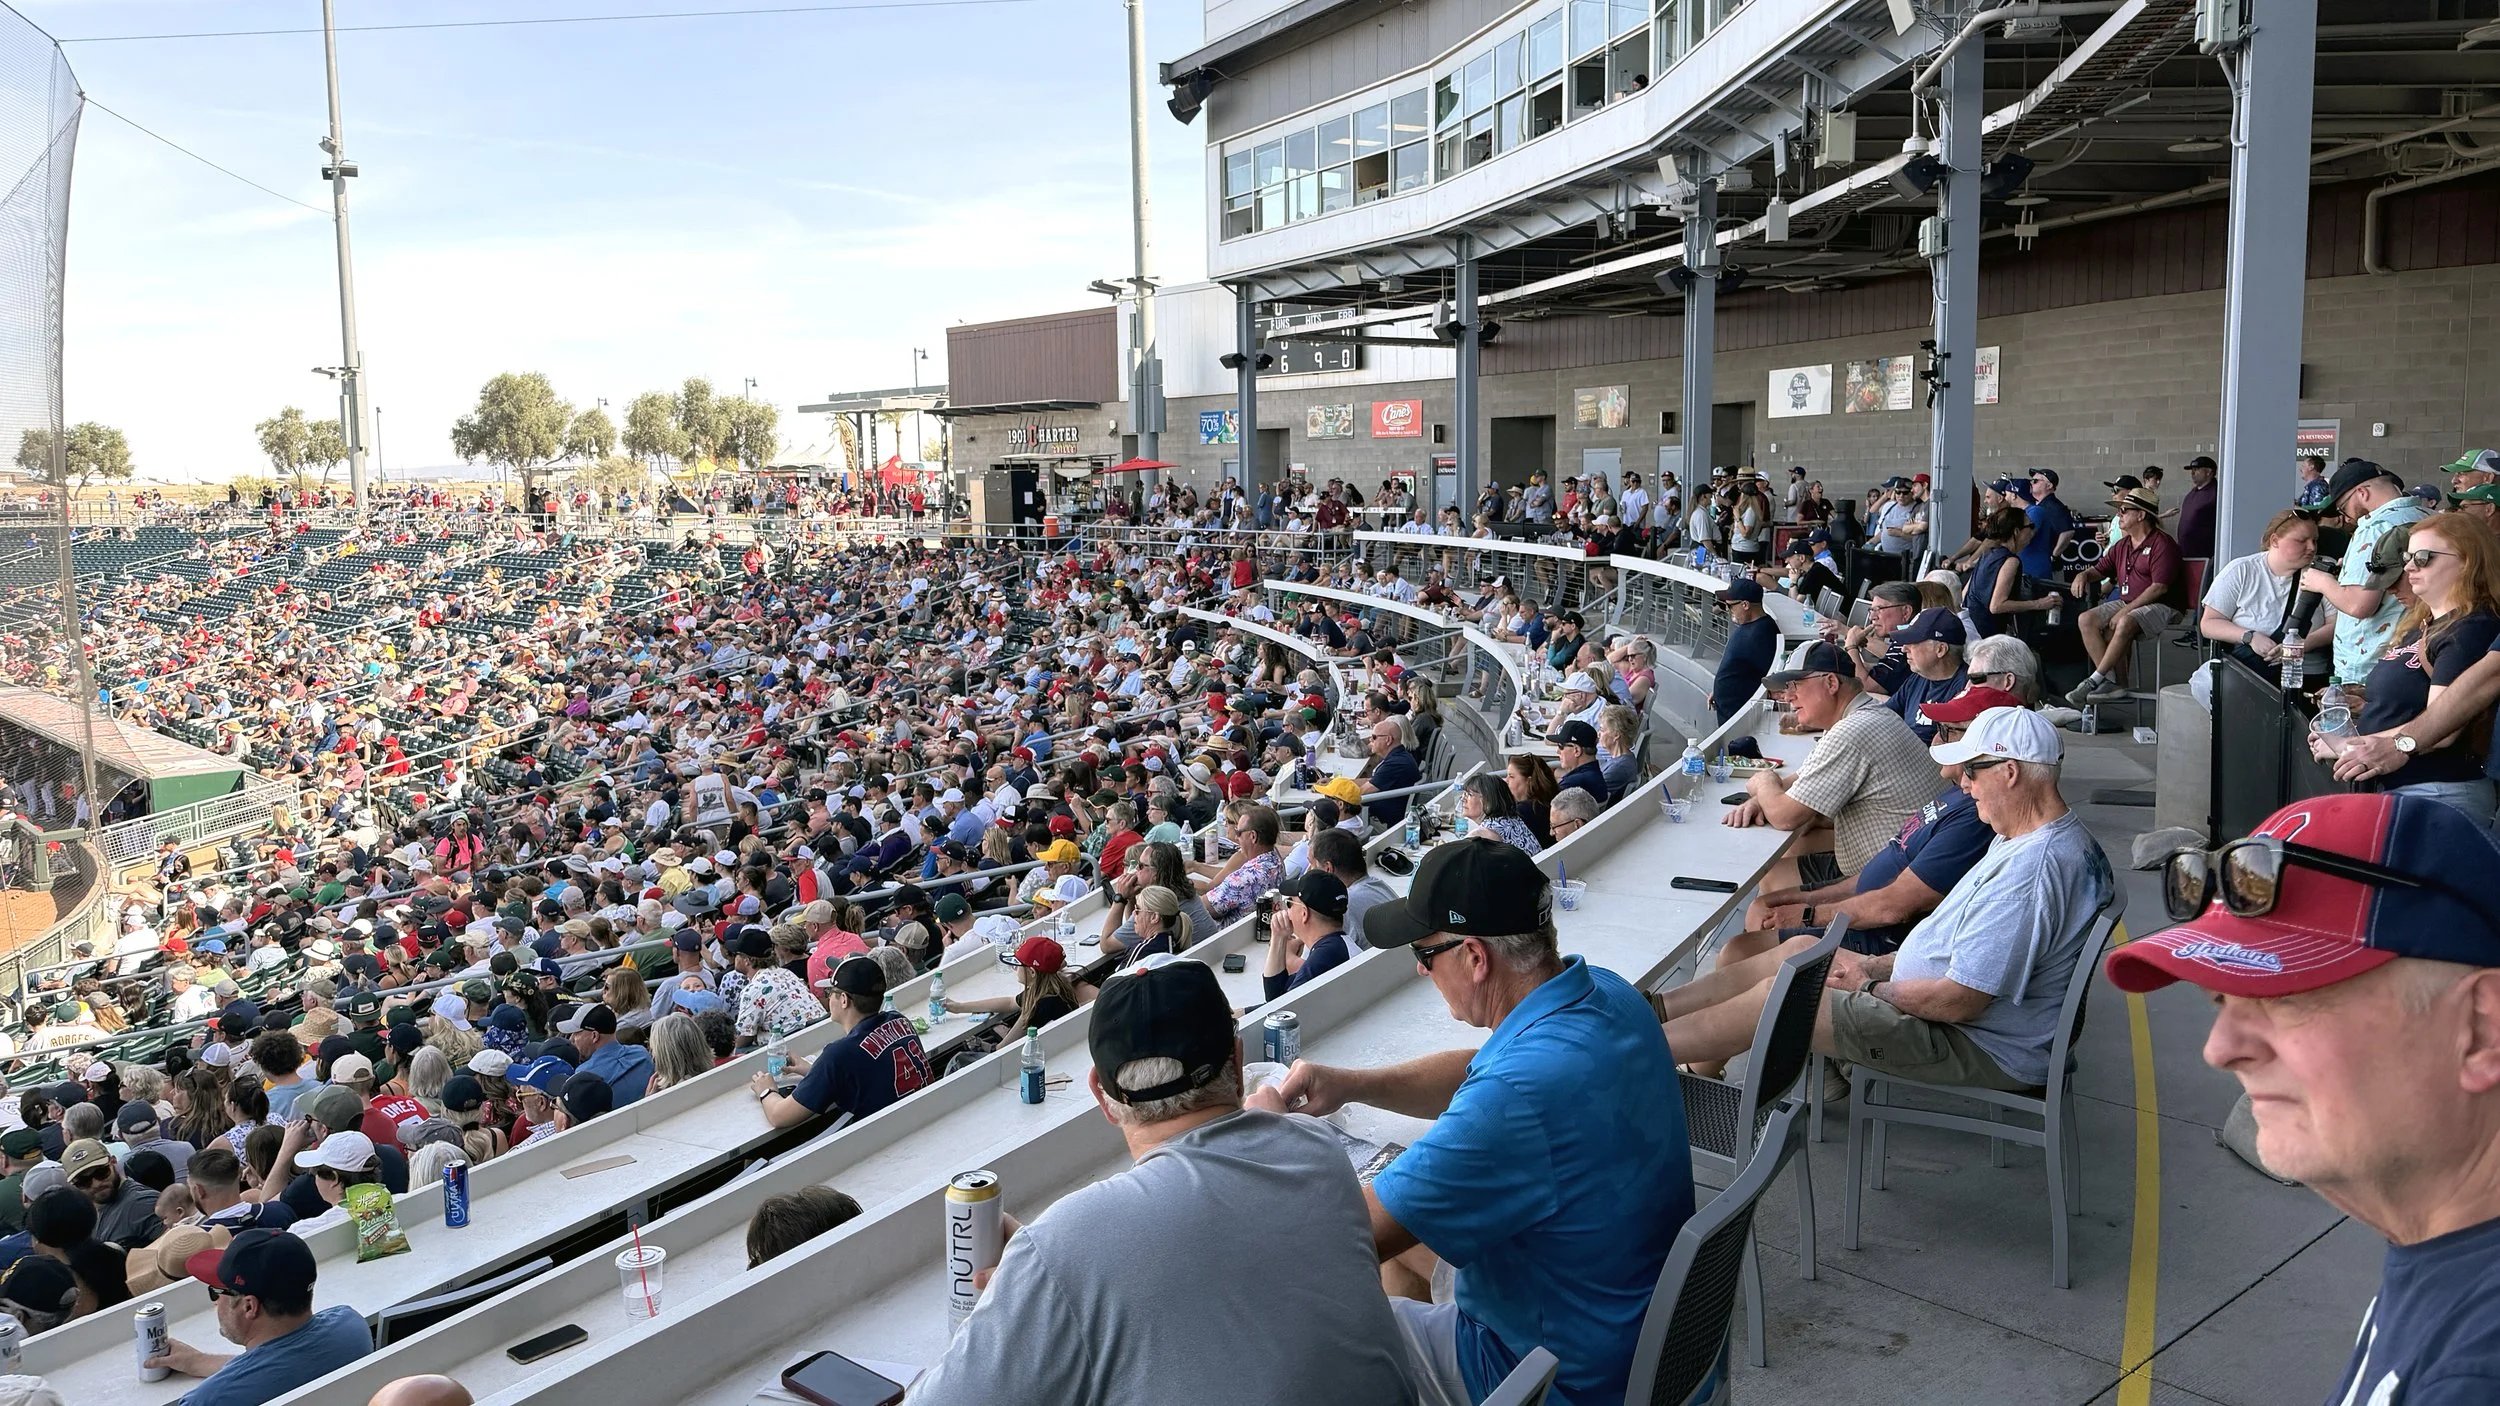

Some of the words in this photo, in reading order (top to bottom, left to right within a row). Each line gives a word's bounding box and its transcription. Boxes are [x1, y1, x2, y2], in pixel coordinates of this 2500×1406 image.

[1281, 355, 1289, 373] 6
[1314, 351, 1323, 369] 9
[1341, 349, 1350, 368] 0
[1008, 429, 1027, 444] 1901
[1027, 425, 1080, 448] CHARTER
[2296, 447, 2330, 457] RANCE
[2172, 941, 2282, 971] Indians
[859, 1017, 917, 1060] MARTINE
[892, 1038, 936, 1098] 41
[449, 1184, 464, 1221] ULTRA
